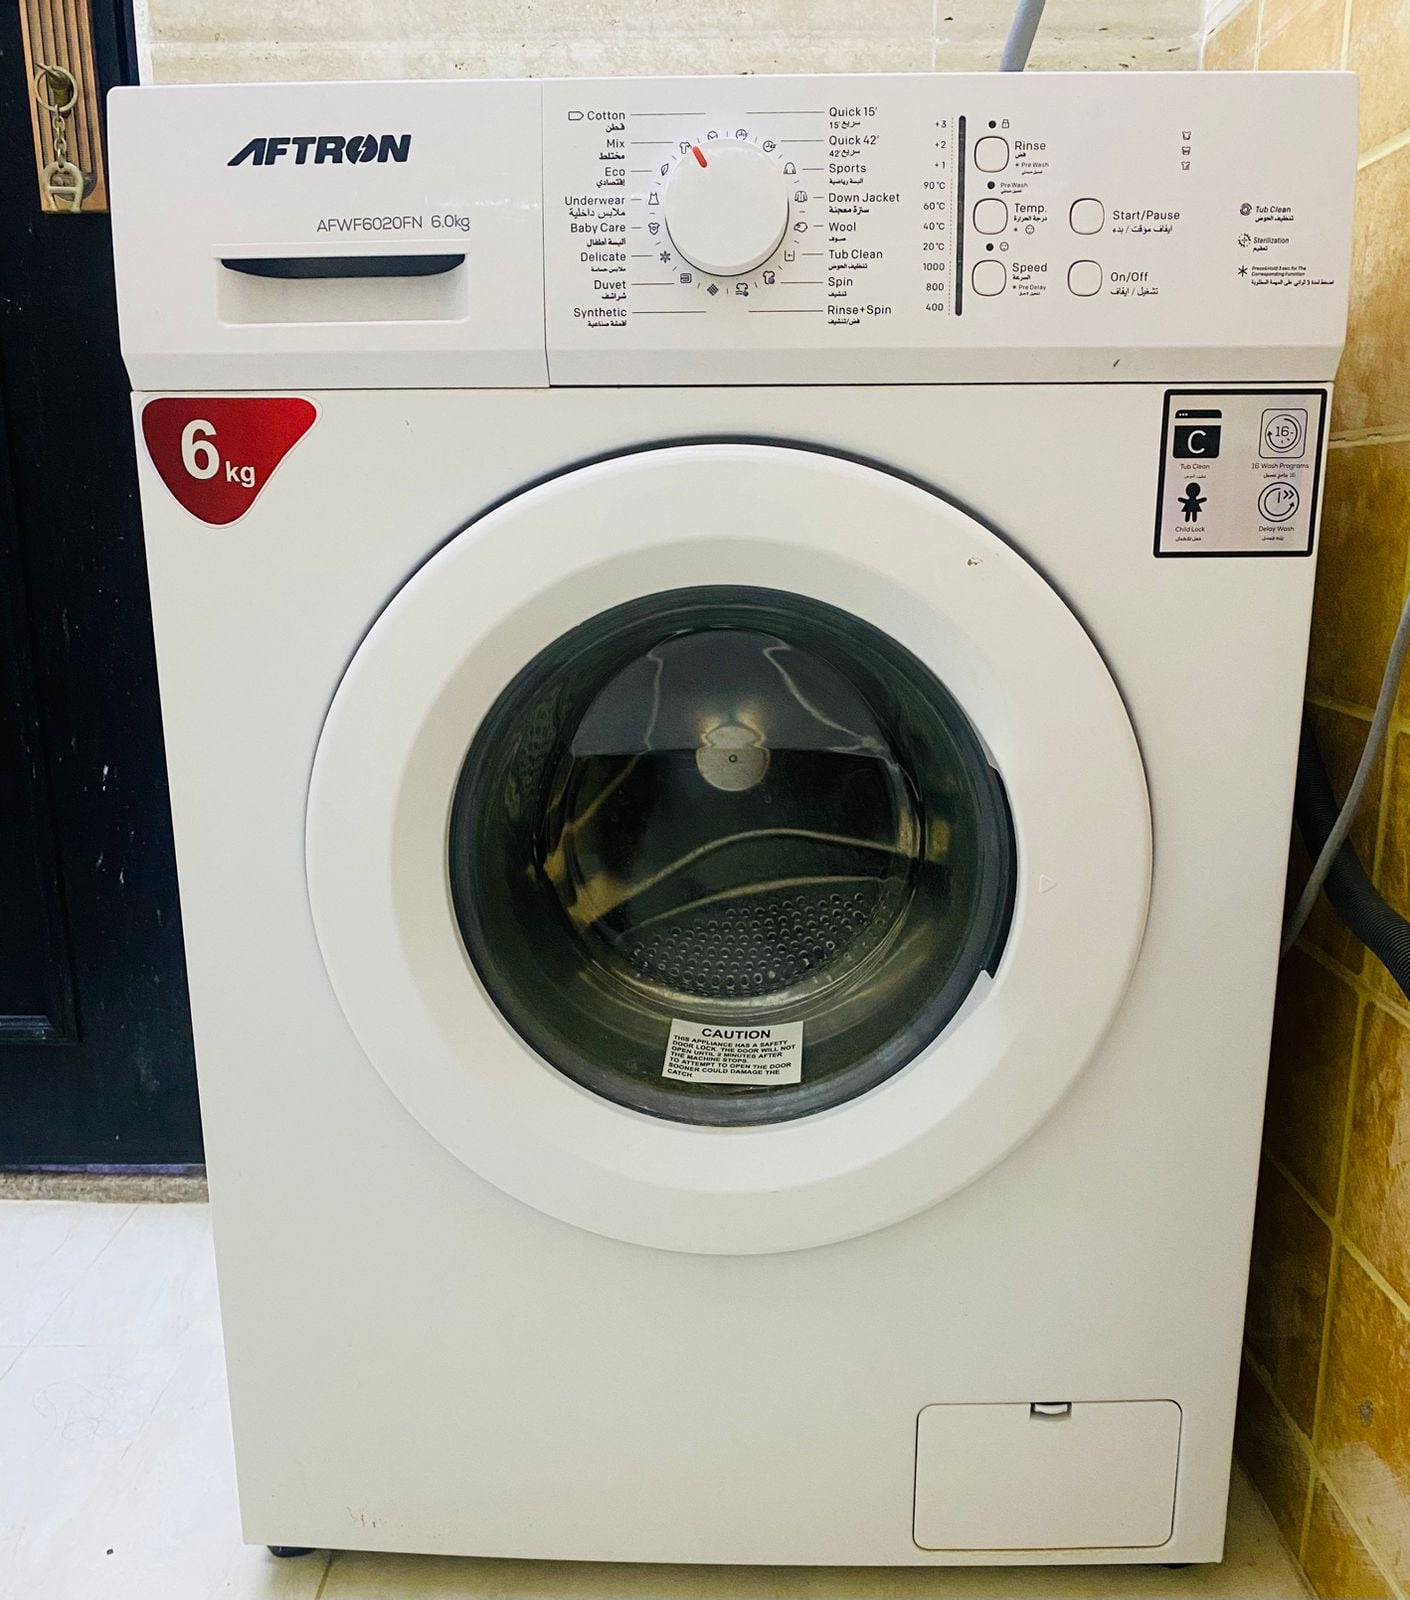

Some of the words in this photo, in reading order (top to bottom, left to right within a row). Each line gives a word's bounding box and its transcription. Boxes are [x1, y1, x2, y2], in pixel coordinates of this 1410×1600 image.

[587, 110, 626, 120] Cotton
[829, 107, 861, 117] Quick
[606, 139, 625, 148] Mix
[829, 135, 861, 145] Quick
[227, 133, 412, 166] AFTRON
[1014, 141, 1046, 150] Rinse
[605, 167, 625, 177] Eco
[829, 163, 867, 174] Sports
[564, 196, 625, 205] Underwear
[828, 193, 860, 203] Down
[862, 192, 900, 202] Jacket
[569, 208, 595, 219] داخلية
[598, 208, 626, 219] ملابس
[1112, 210, 1180, 221] Start/Pause
[316, 215, 423, 233] AFWF6020FN
[431, 214, 470, 232] 6.0kg
[570, 222, 598, 234] Baby
[600, 222, 626, 232] Care
[829, 222, 856, 232] Wool
[1253, 236, 1289, 244] Sterilization
[580, 252, 626, 262] Delicate
[829, 249, 849, 259] Tub
[851, 249, 883, 259] Clean
[923, 263, 945, 271] 1000
[1012, 262, 1048, 273] Speed
[1110, 271, 1148, 283] On/Off
[594, 280, 626, 290] Duvet
[828, 277, 853, 288] Spin
[926, 283, 944, 291] 800
[828, 304, 892, 316] Rinse+Spin
[925, 303, 944, 311] 400
[573, 307, 627, 319] Synthetic
[1275, 426, 1289, 437] 16
[1187, 430, 1207, 454] C
[181, 419, 220, 480] 6
[225, 461, 256, 488] kg
[1279, 462, 1310, 471] Programs
[702, 1028, 771, 1040] CAUTION
[672, 1040, 694, 1049] DOOR
[691, 1038, 733, 1048] APPLIANCE
[760, 1039, 788, 1047] SAFETY
[671, 1045, 692, 1054] OPEN
[668, 1062, 700, 1072] SOONER
[667, 1068, 693, 1078] CATCH
